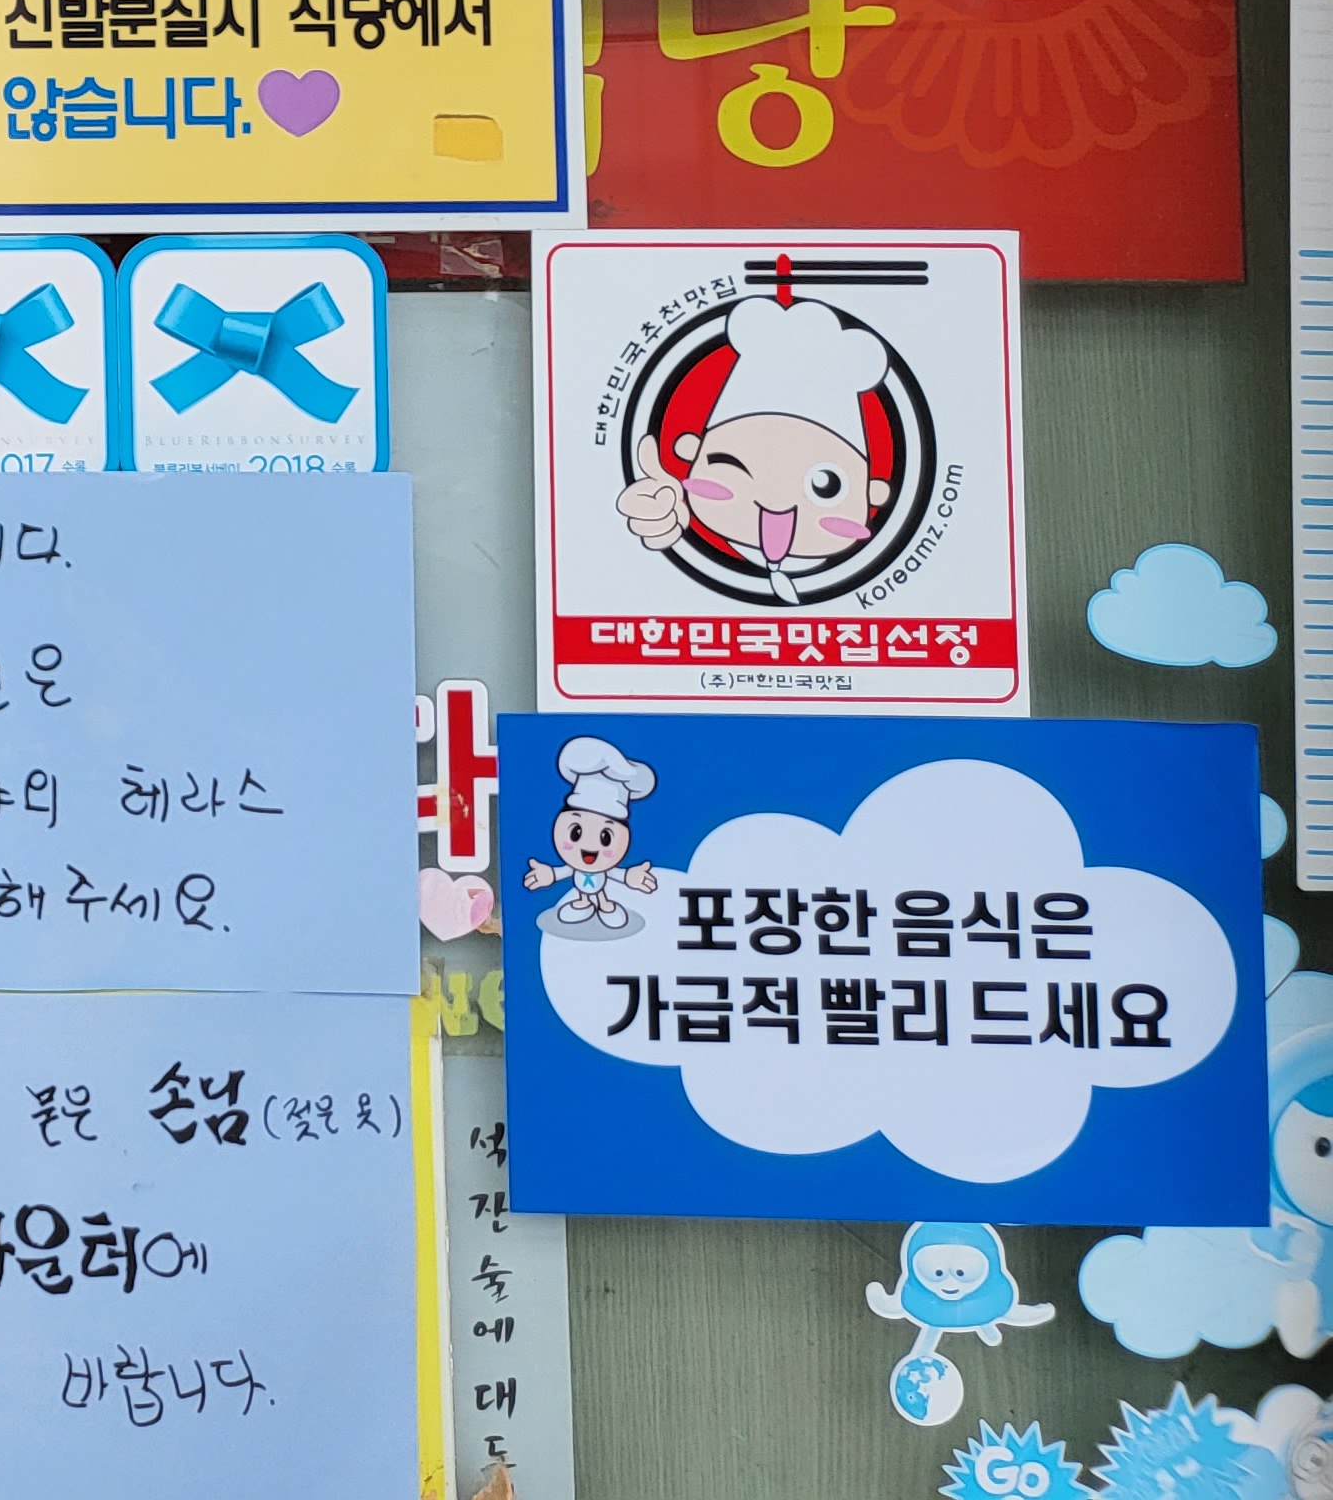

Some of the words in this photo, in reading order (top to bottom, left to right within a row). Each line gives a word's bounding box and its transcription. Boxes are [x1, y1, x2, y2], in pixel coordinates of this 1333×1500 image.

[3, 74, 252, 142] 않습니다.
[594, 275, 739, 447] 대한민국추천맛집
[248, 454, 325, 472] 2018
[856, 462, 965, 610] koreamz.com
[590, 620, 979, 665] 대한민국맛집선정
[699, 671, 853, 692] (주)대한민국맛집
[676, 887, 877, 958] 포장한
[891, 888, 1094, 961] 음식은
[605, 973, 801, 1045] 가급적
[820, 976, 949, 1047] 빨리
[970, 979, 1172, 1050] 드세요
[148, 1060, 248, 1146] 손님
[62, 1344, 277, 1427] 바랍니다.
[974, 1445, 1050, 1497] Go
